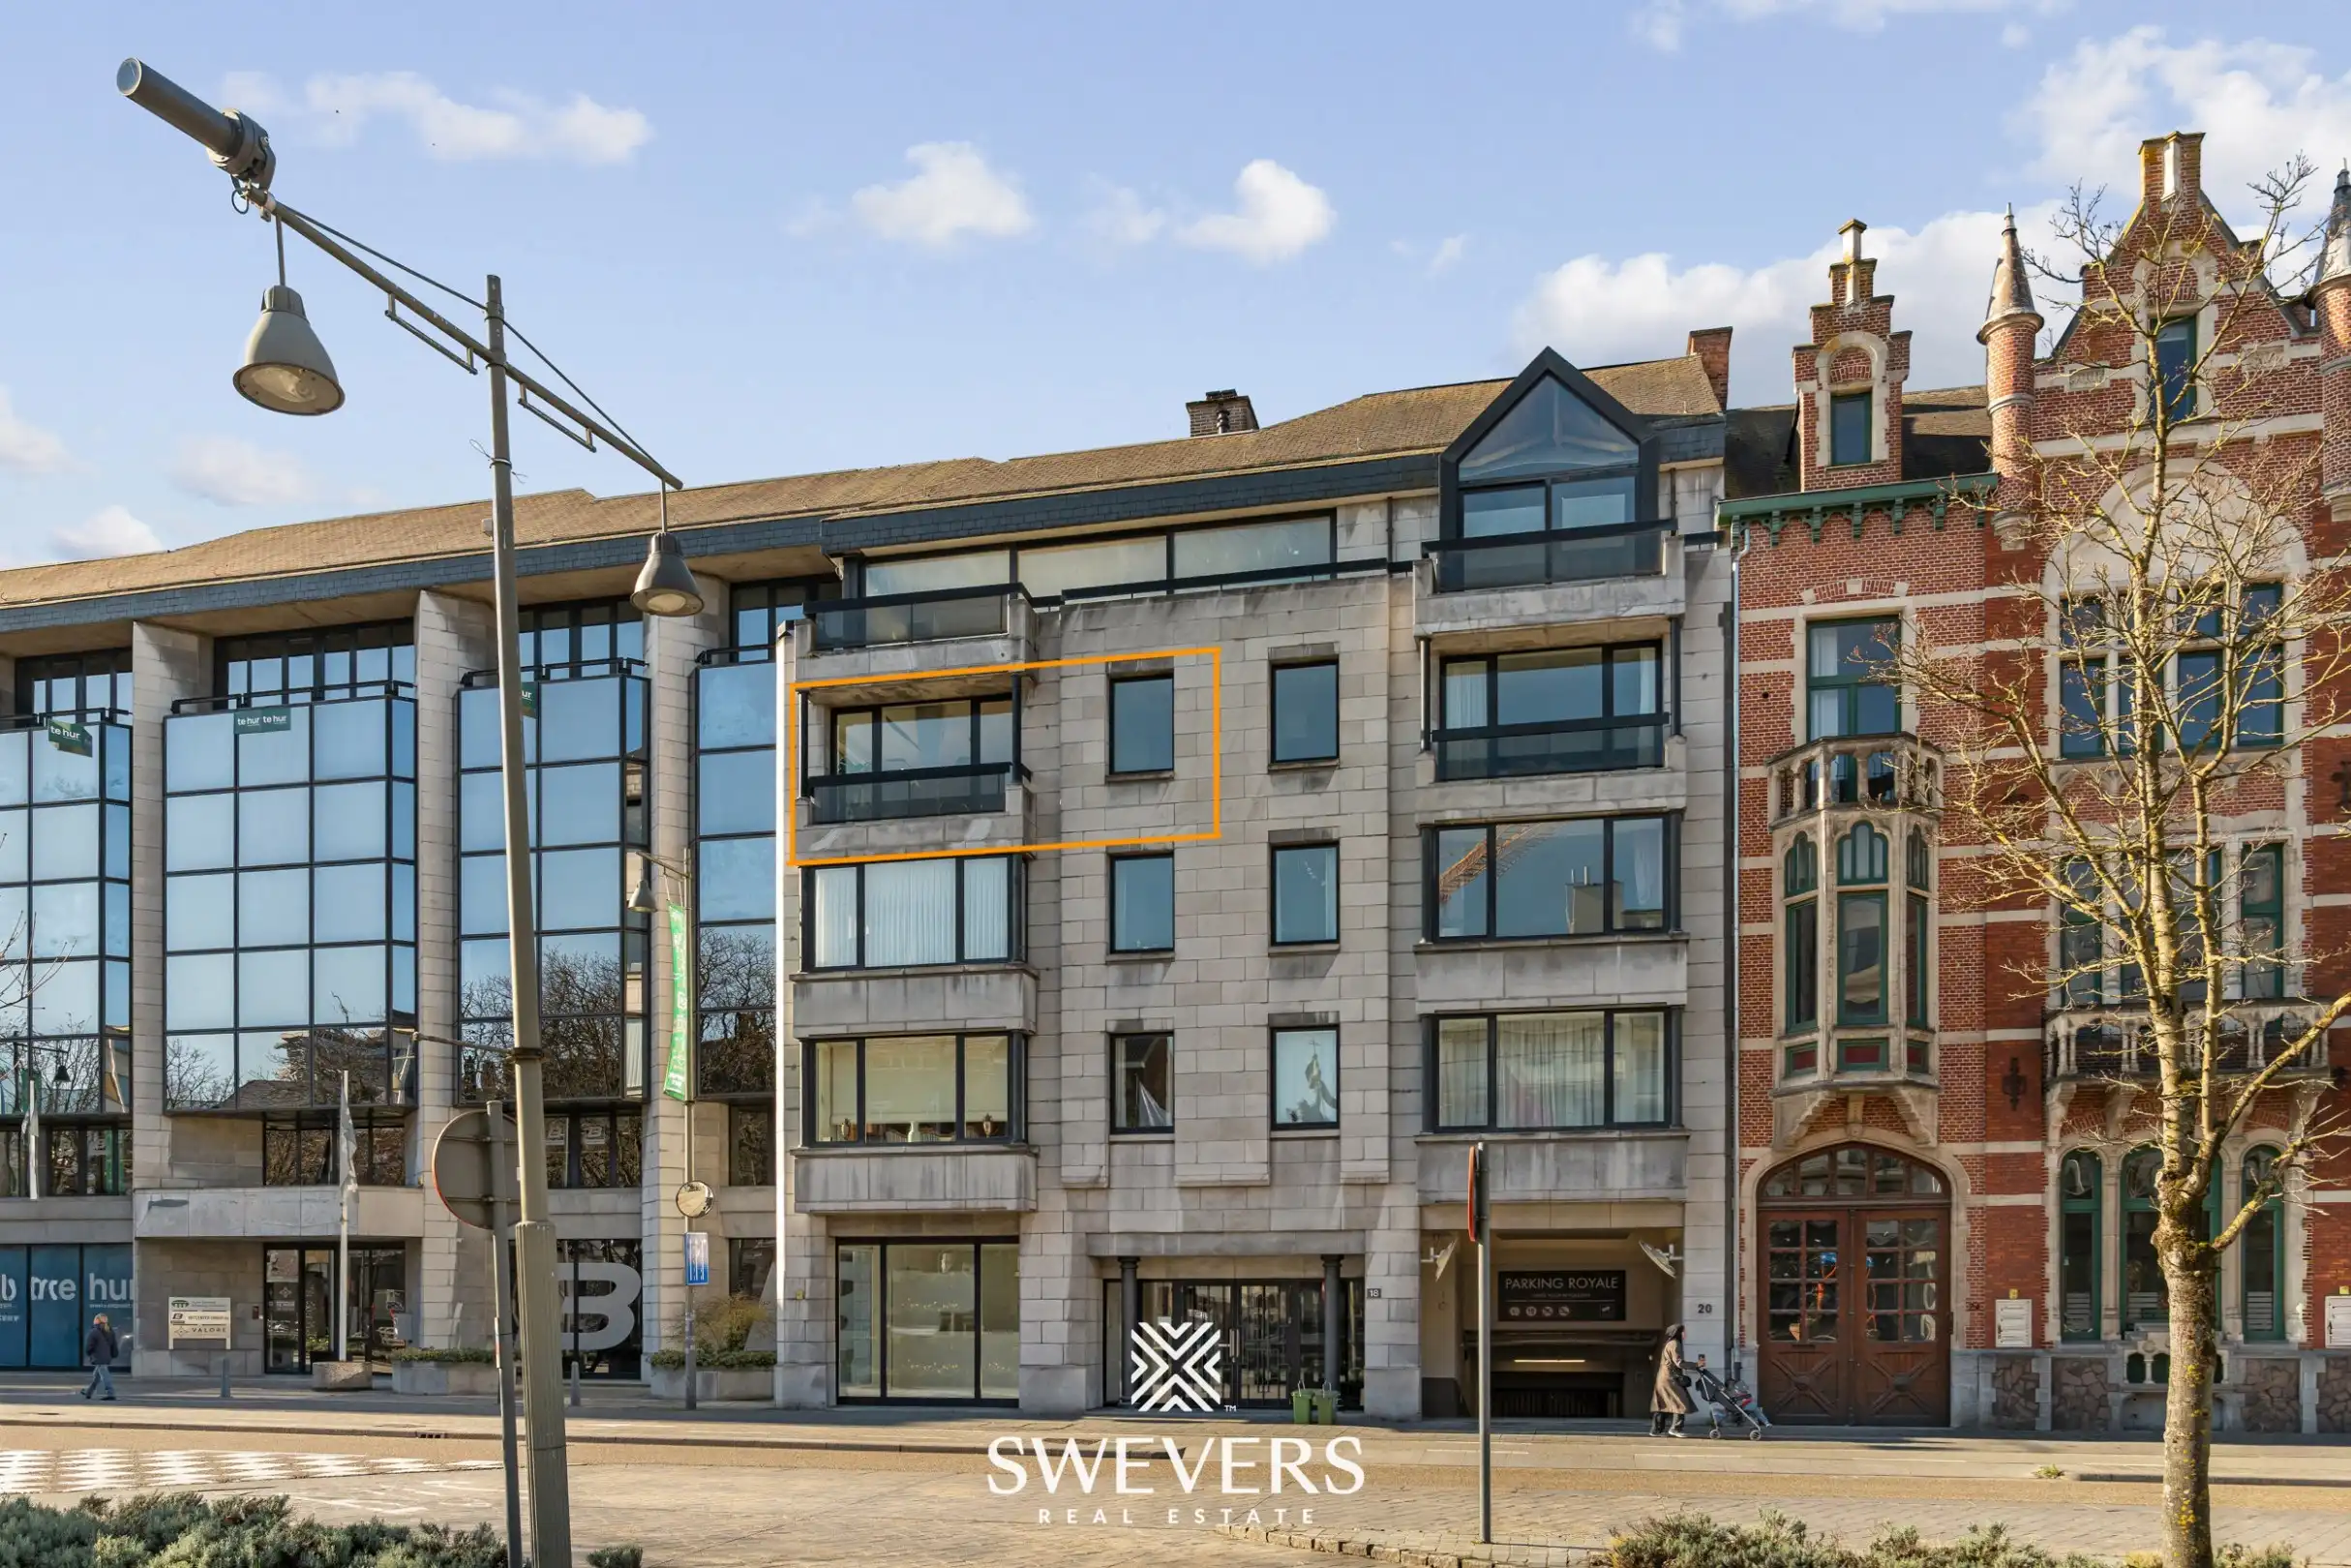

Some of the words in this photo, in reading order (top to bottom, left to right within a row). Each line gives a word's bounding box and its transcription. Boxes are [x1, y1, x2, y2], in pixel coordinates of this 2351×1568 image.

[50, 726, 62, 736] te
[1505, 1278, 1564, 1289] PARKING
[1568, 1277, 1619, 1289] ROYALE
[1369, 1288, 1379, 1297] 18
[1698, 1303, 1712, 1314] 20
